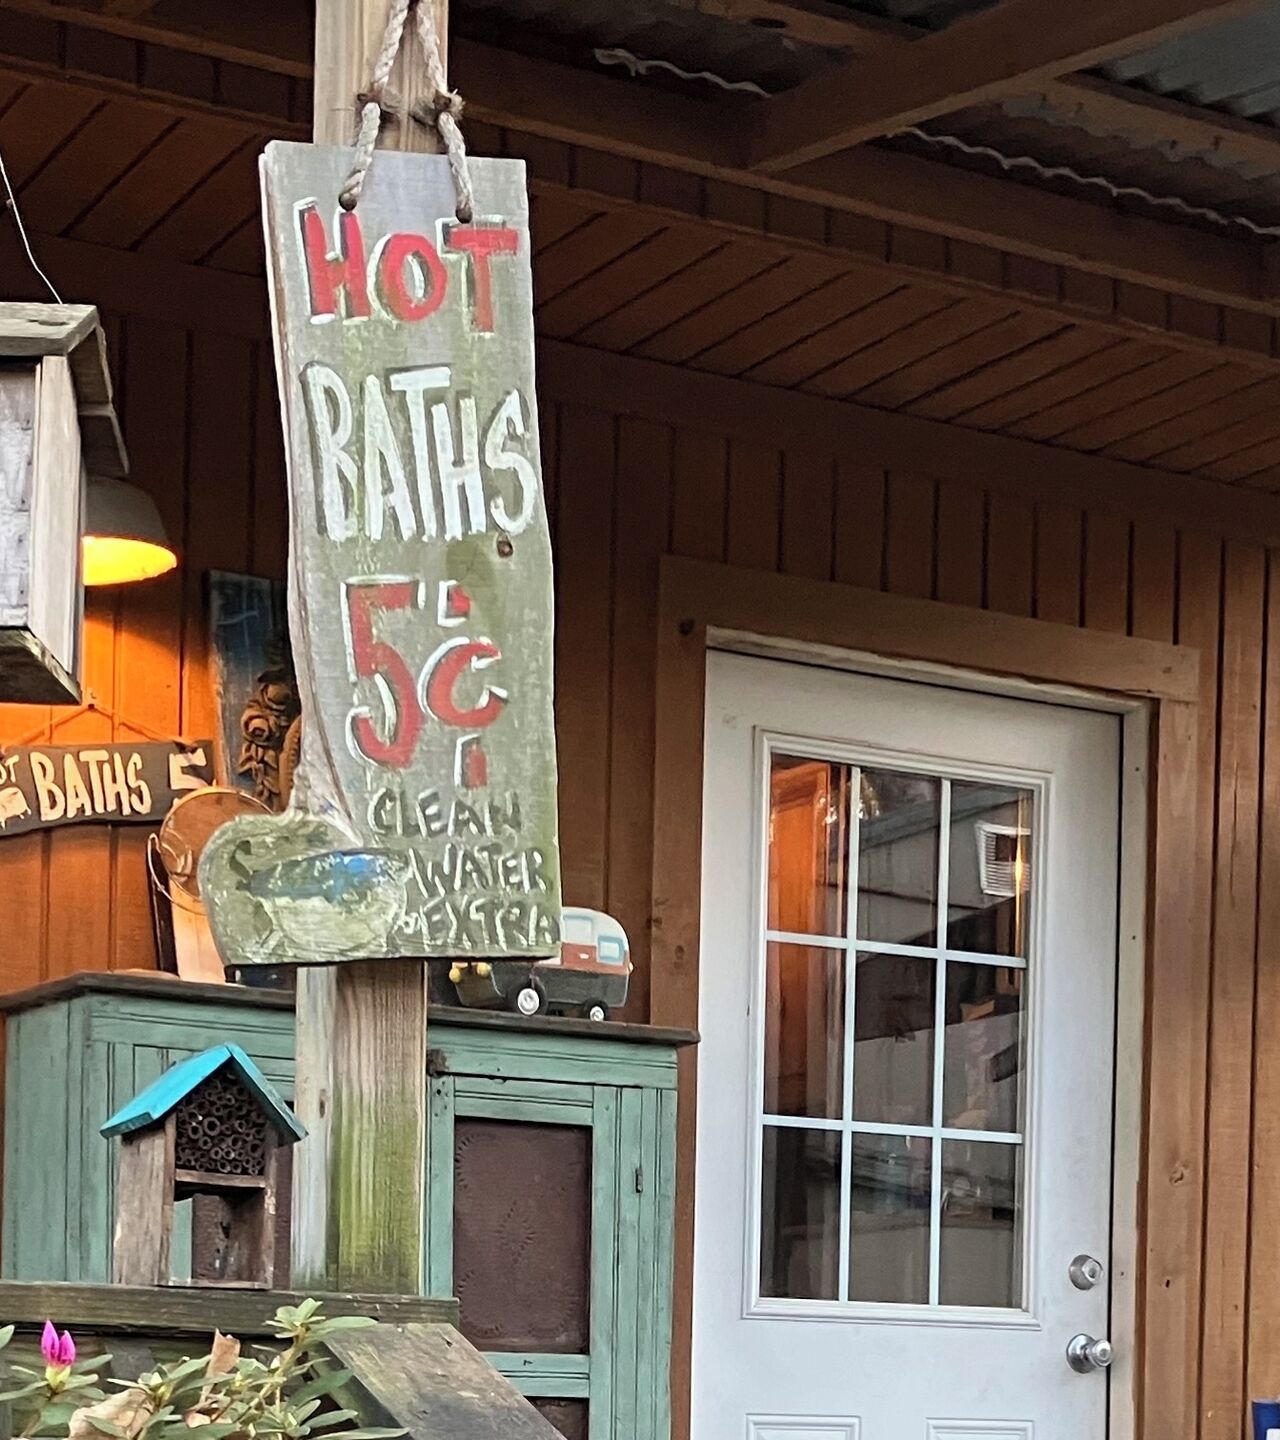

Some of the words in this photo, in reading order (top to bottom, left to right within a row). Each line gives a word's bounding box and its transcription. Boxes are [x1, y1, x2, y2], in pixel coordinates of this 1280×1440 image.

[293, 198, 518, 334] HOT
[300, 360, 537, 544] BATHS
[31, 749, 152, 821] BATHS
[367, 787, 521, 838] CLEAN
[409, 843, 553, 898] WATER
[419, 895, 561, 951] EXTRA
